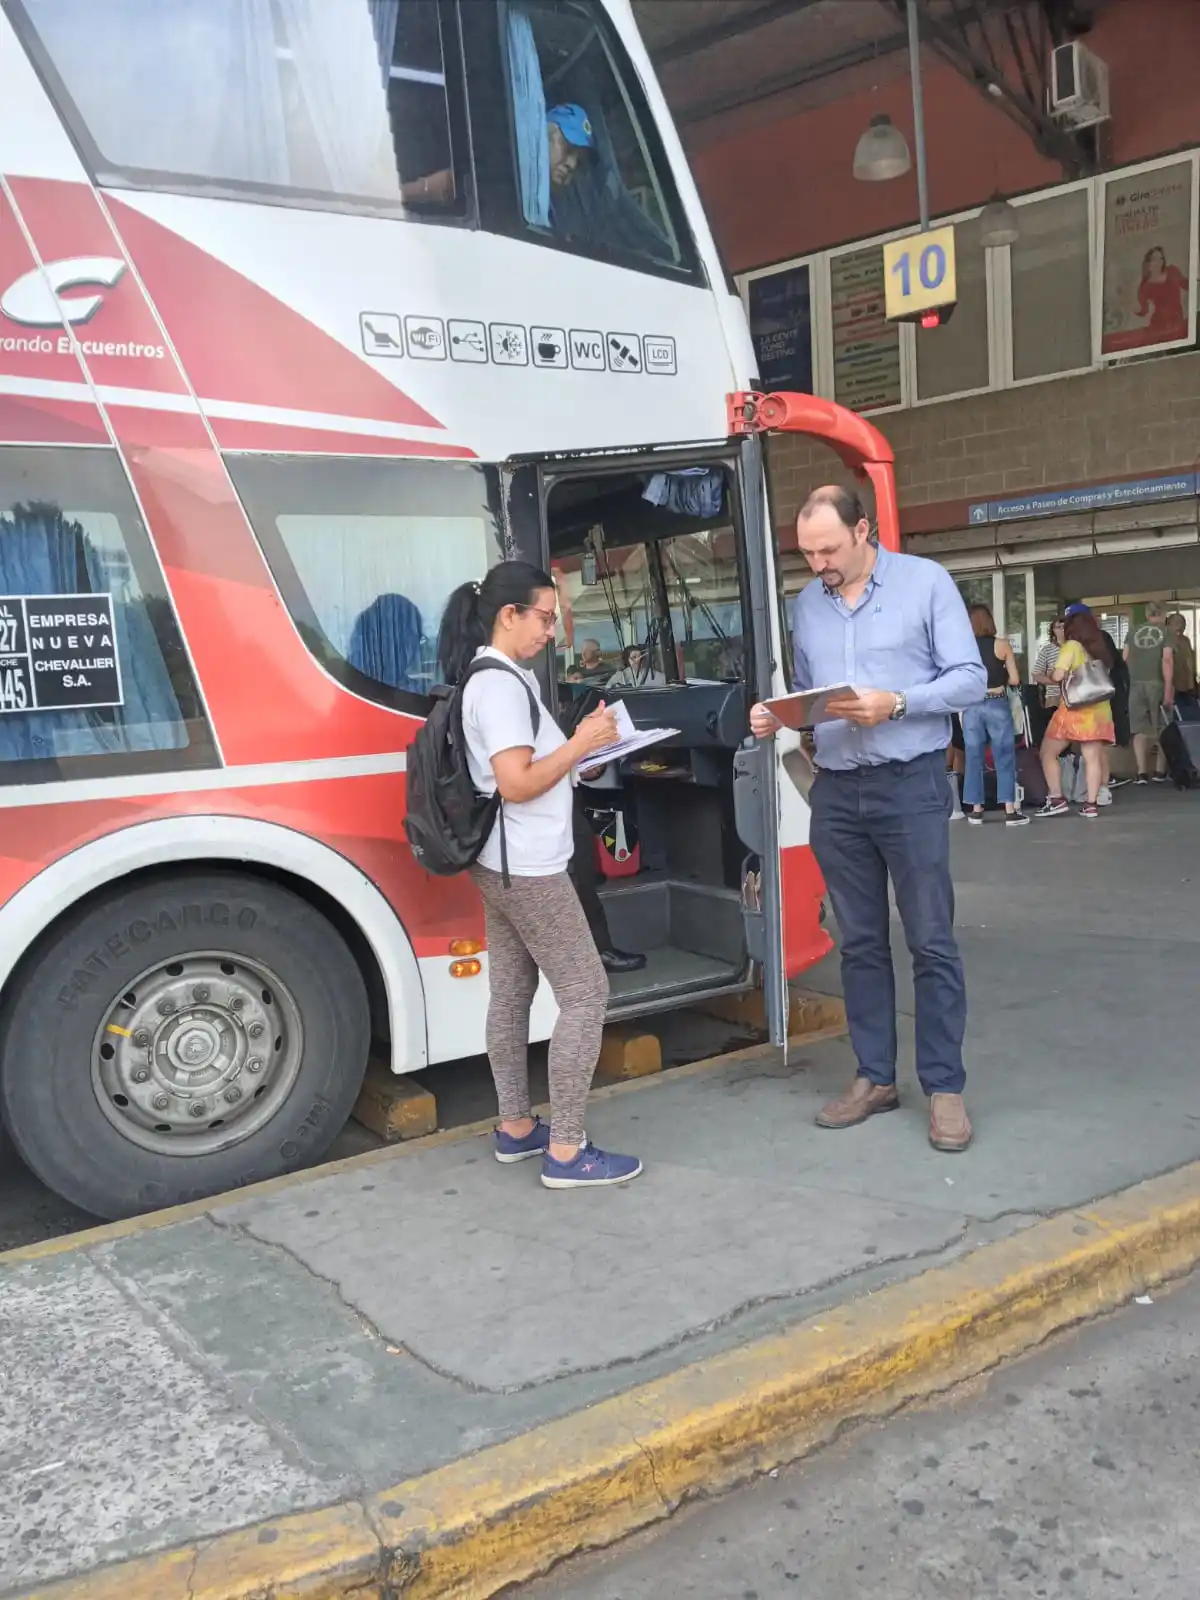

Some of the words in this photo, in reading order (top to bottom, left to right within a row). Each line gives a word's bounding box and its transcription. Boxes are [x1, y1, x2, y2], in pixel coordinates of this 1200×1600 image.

[892, 244, 946, 296] 10
[574, 341, 601, 359] WC
[652, 349, 669, 359] LCD
[998, 504, 1025, 515] Acceso
[1032, 501, 1056, 509] Paseo
[1057, 496, 1068, 505] de
[1069, 493, 1106, 504] Compras
[29, 613, 110, 628] EMPRESA
[32, 635, 112, 650] NUEVA
[34, 657, 114, 672] CHEVALLIER
[62, 675, 92, 688] S.A.
